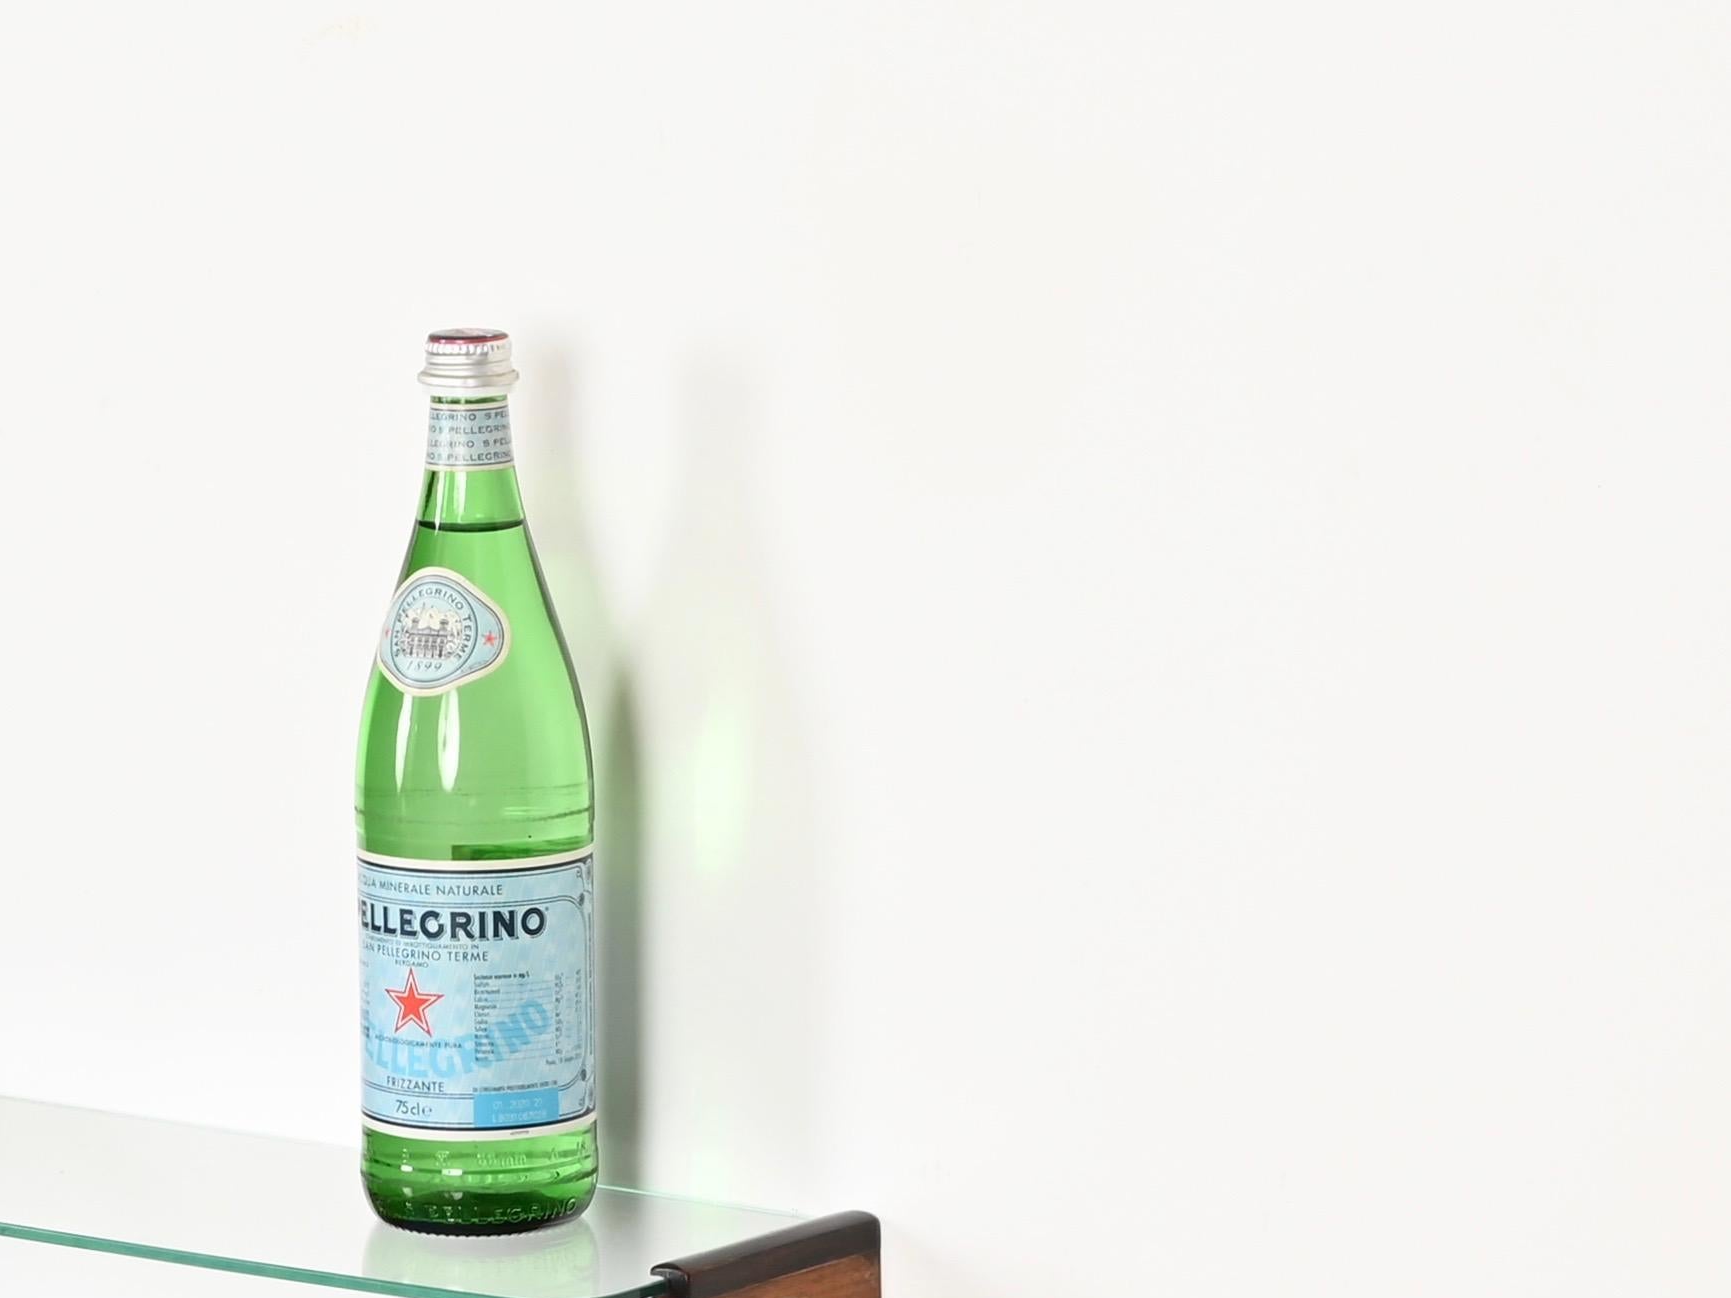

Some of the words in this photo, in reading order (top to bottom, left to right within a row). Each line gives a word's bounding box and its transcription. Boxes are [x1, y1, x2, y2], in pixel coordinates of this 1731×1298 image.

[397, 587, 464, 623] PELLEGRINO
[454, 614, 473, 659] TERME
[379, 880, 431, 895] MINERALE
[436, 884, 503, 897] NATURALE
[359, 898, 547, 942] ELLEGRINO
[376, 944, 441, 961] PELLEGRINO
[447, 951, 489, 962] TERME
[386, 1075, 445, 1093] FRIZZANTE
